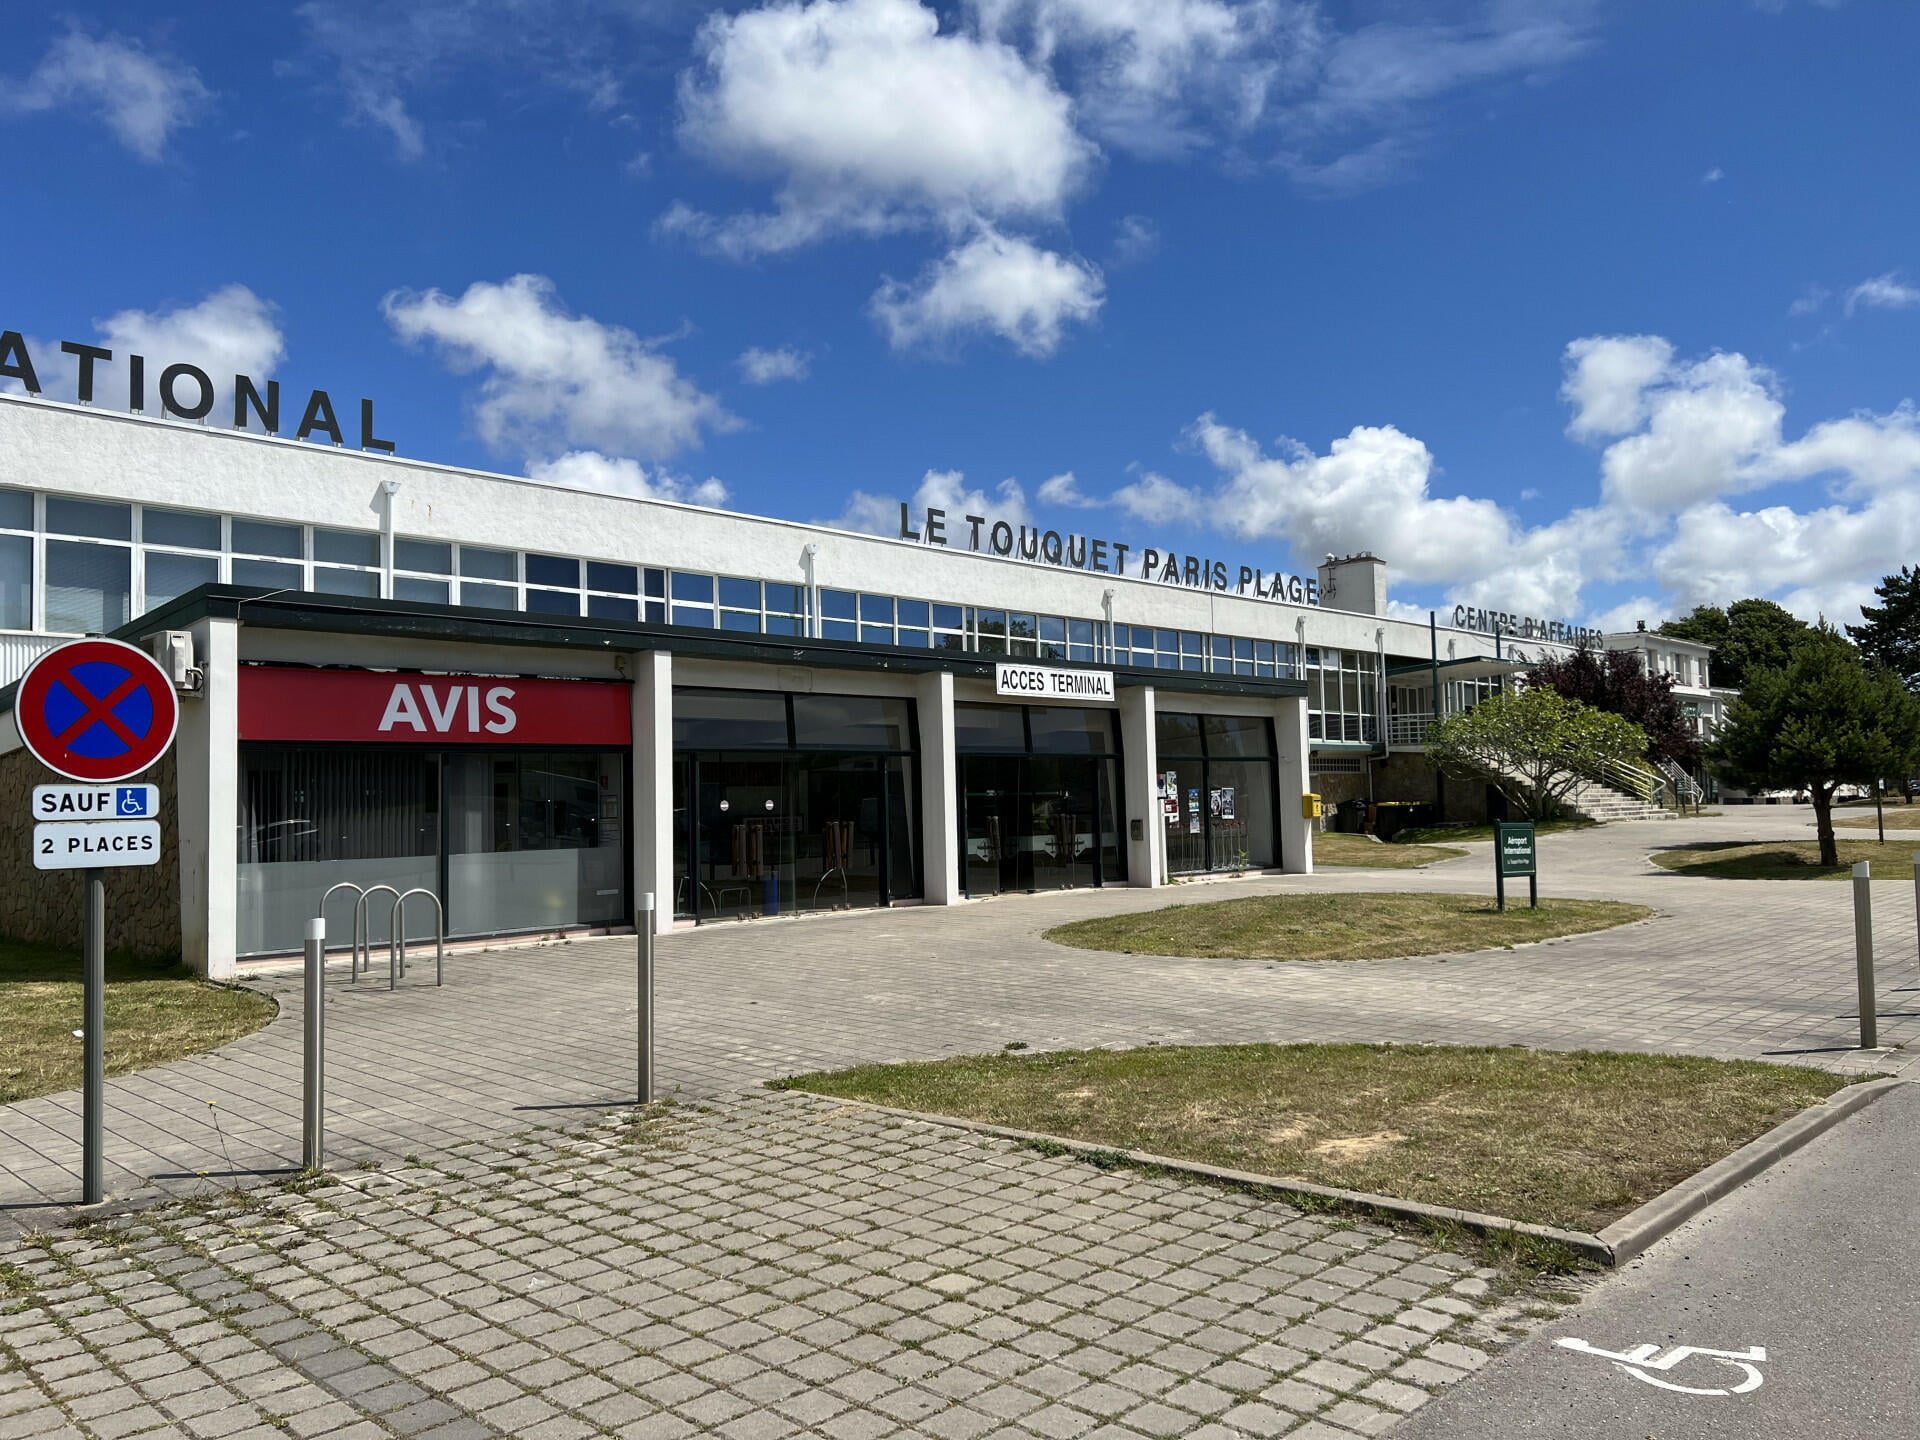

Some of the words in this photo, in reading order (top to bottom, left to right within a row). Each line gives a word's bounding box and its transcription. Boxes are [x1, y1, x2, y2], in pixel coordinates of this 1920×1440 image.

[900, 502, 947, 545] LE
[966, 515, 1129, 575] TOUQUET
[1143, 548, 1227, 591] PARIS
[1239, 565, 1318, 606] PLAGE
[1455, 604, 1517, 636] CENTRE
[1525, 616, 1604, 650] D'AFFAIRES
[1001, 669, 1045, 691] ACCES
[1050, 673, 1111, 695] TERMINAL
[377, 683, 517, 735] AVIS
[41, 792, 111, 813] SAUF
[41, 838, 54, 854] 2
[68, 835, 153, 853] PLACES
